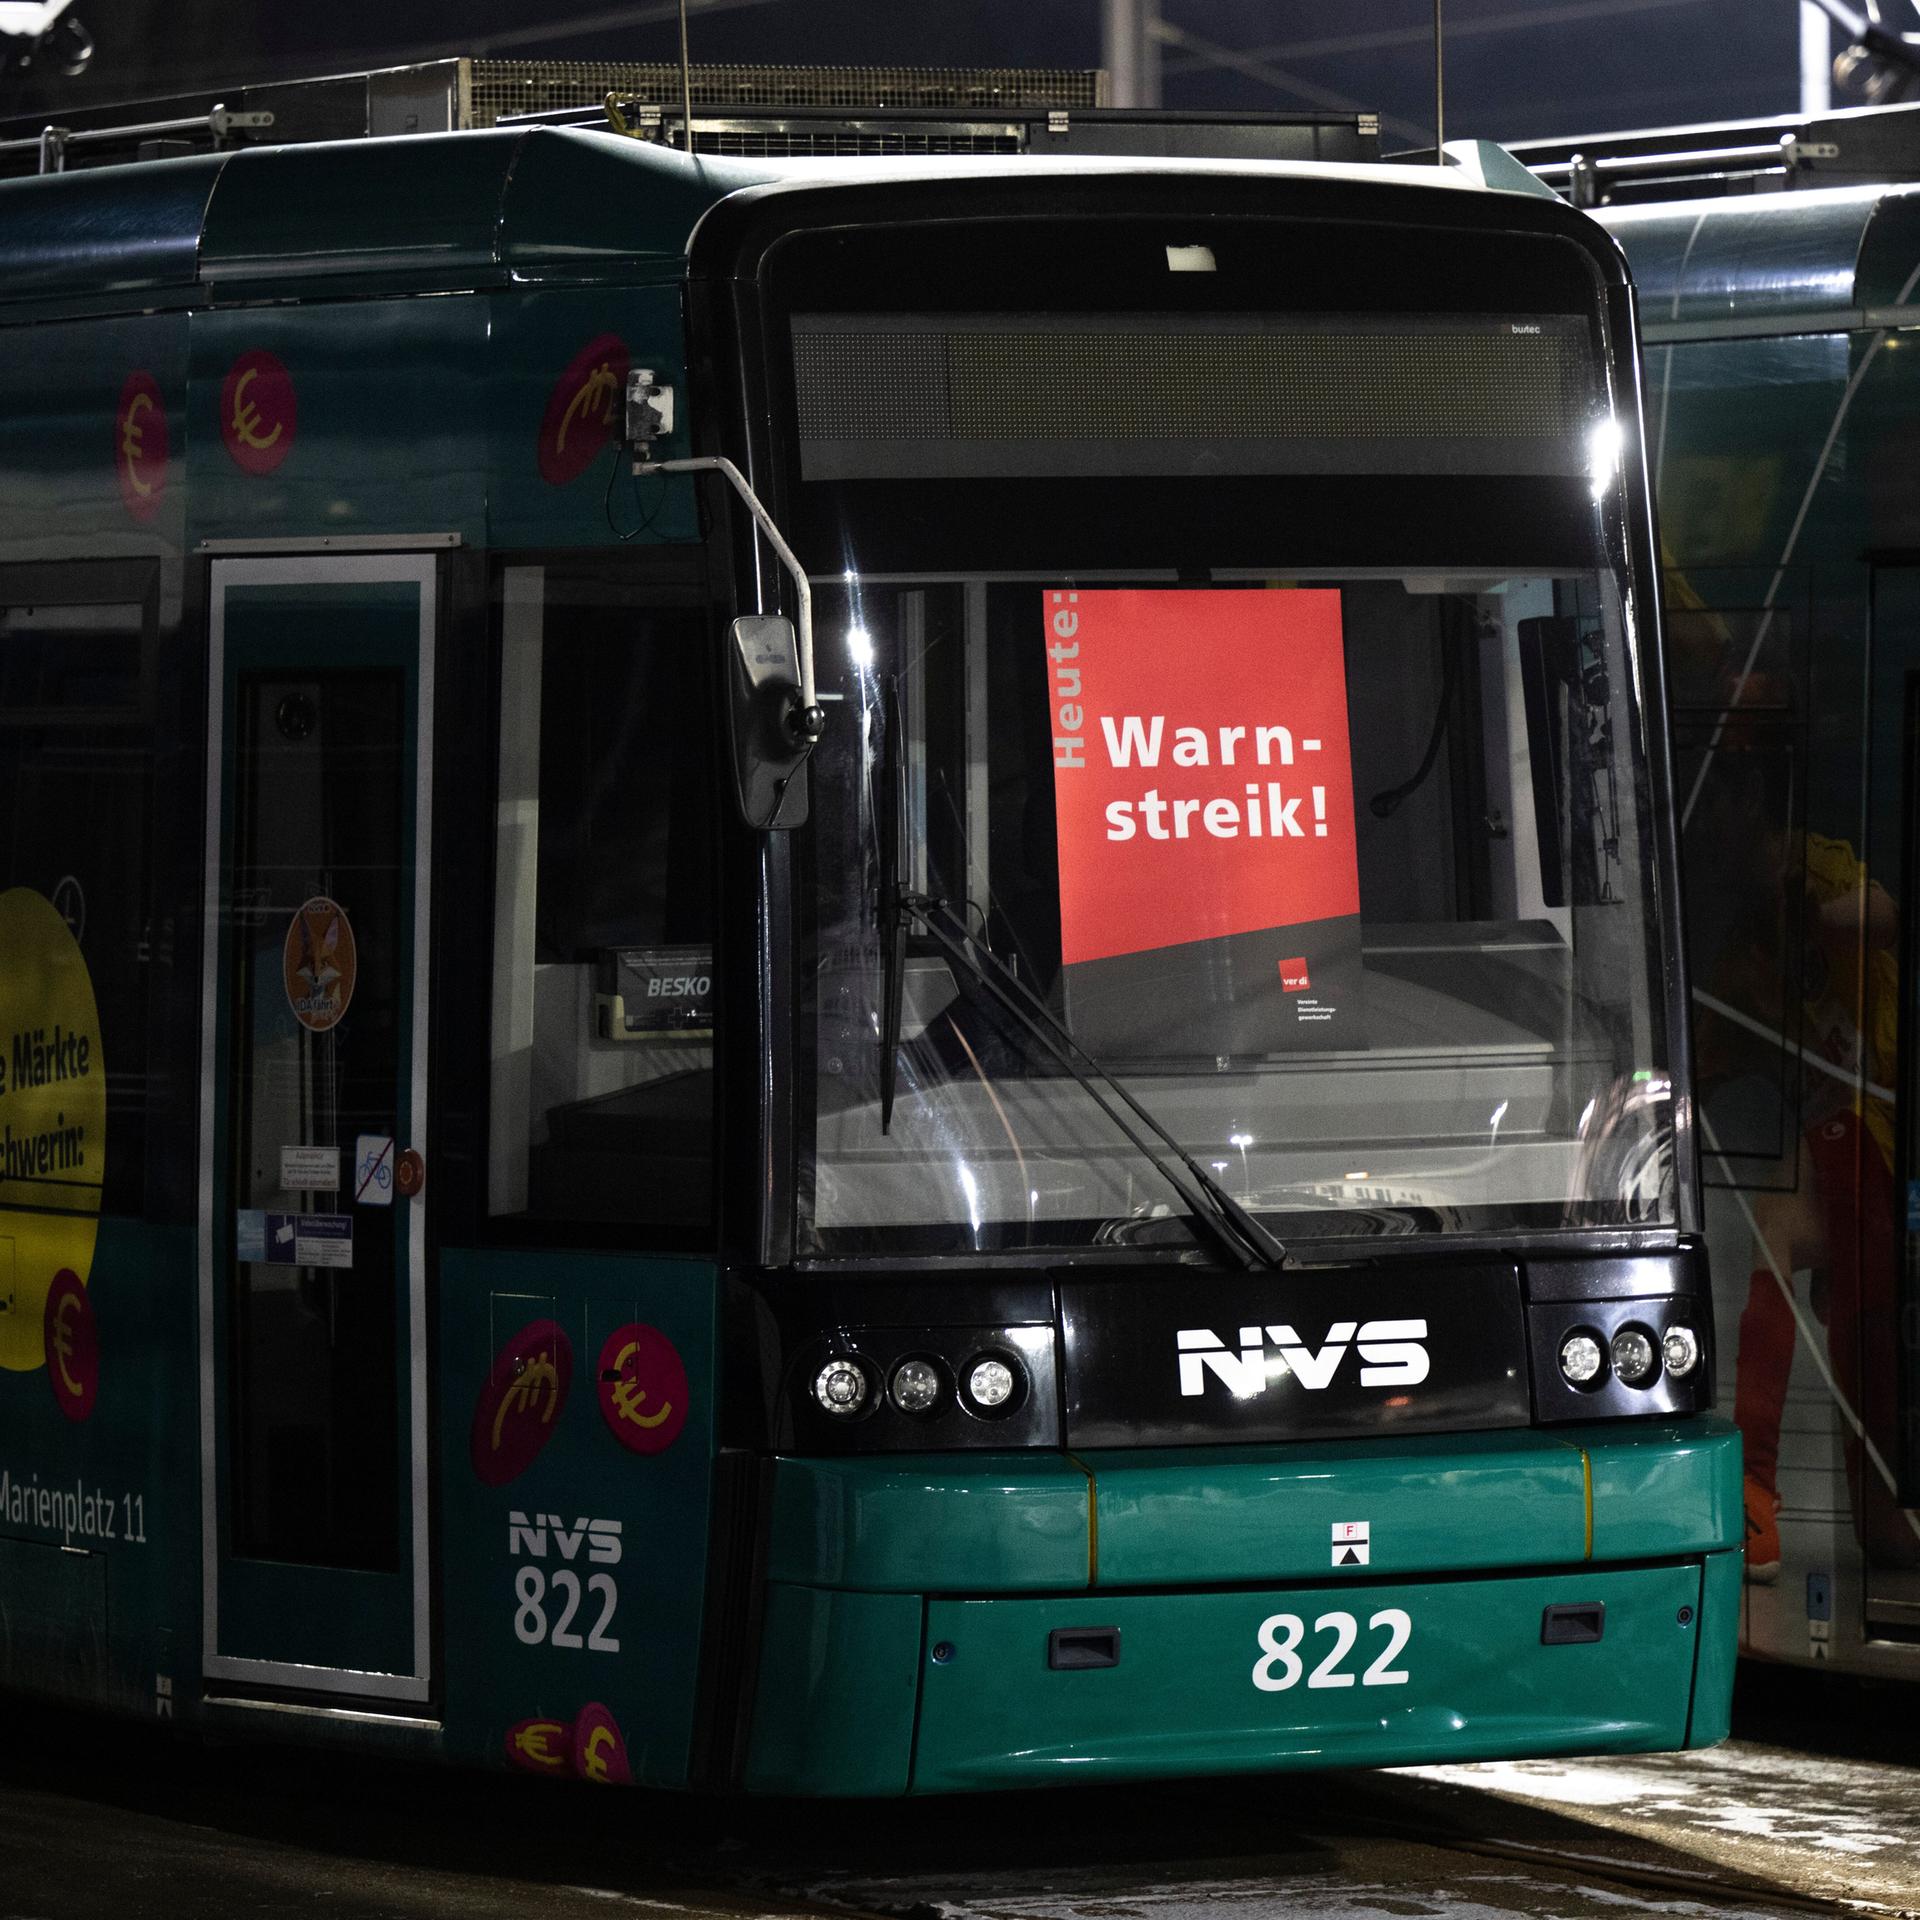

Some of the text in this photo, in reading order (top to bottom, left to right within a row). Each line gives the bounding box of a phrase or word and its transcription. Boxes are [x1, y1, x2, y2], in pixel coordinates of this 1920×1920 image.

[1049, 592, 1085, 769] Heute:
[1100, 715, 1322, 768] Warn-
[1104, 782, 1328, 841] streik!
[647, 975, 712, 998] BESKO
[12, 1024, 90, 1092] Märkte
[1176, 1318, 1431, 1397] NVS
[122, 1491, 147, 1543] 11
[508, 1510, 623, 1565] NVS
[513, 1565, 621, 1653] 822
[1251, 1608, 1412, 1692] 822
